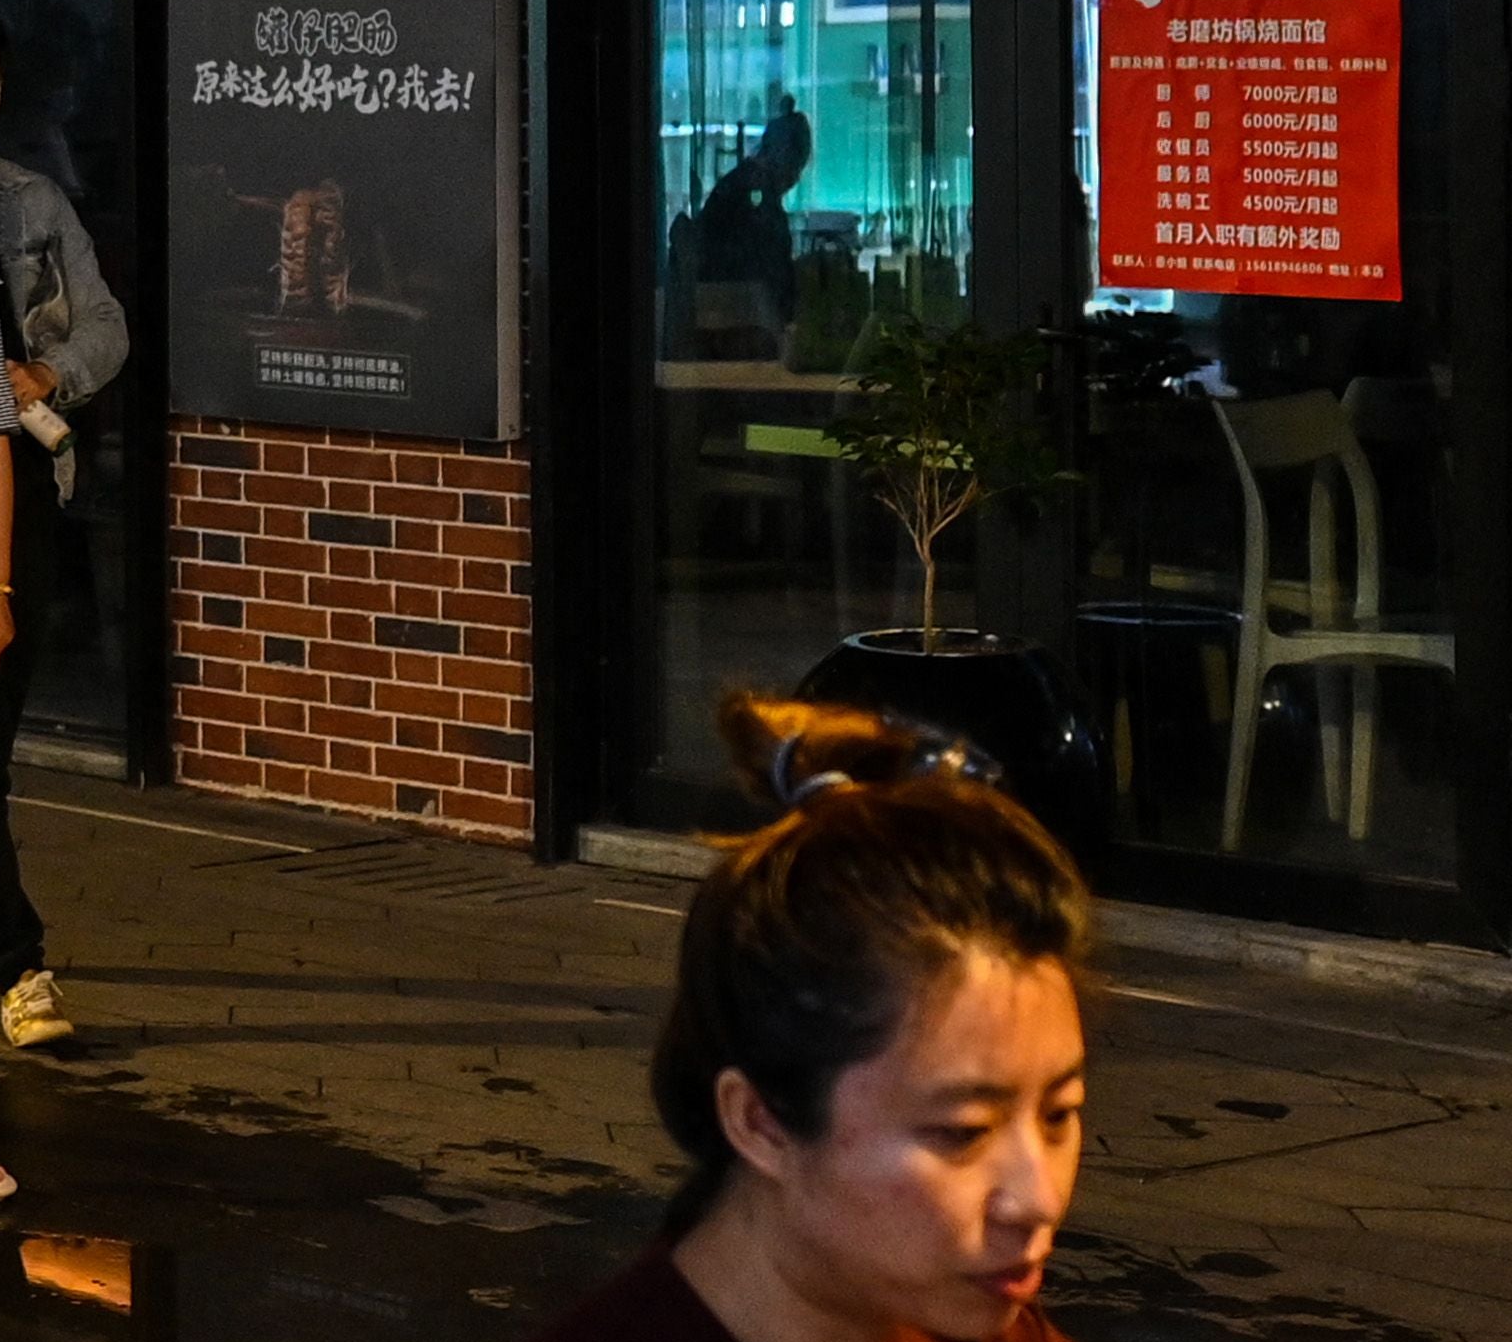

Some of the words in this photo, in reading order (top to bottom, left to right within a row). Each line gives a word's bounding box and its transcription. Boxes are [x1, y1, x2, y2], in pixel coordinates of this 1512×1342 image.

[256, 6, 397, 56] 罐仔肥肠
[1167, 18, 1327, 44] 老磨坊锅烧面馆
[1242, 85, 1338, 104] 7000元/月起
[1242, 113, 1338, 132] 6000元/月起
[1242, 140, 1338, 159] 5500元/月起
[1156, 165, 1212, 184] 服务员
[1242, 168, 1338, 187] 5000元/月起
[1242, 195, 1338, 214] 4500元/月起
[1155, 221, 1341, 251] 首月入职有额外奖励
